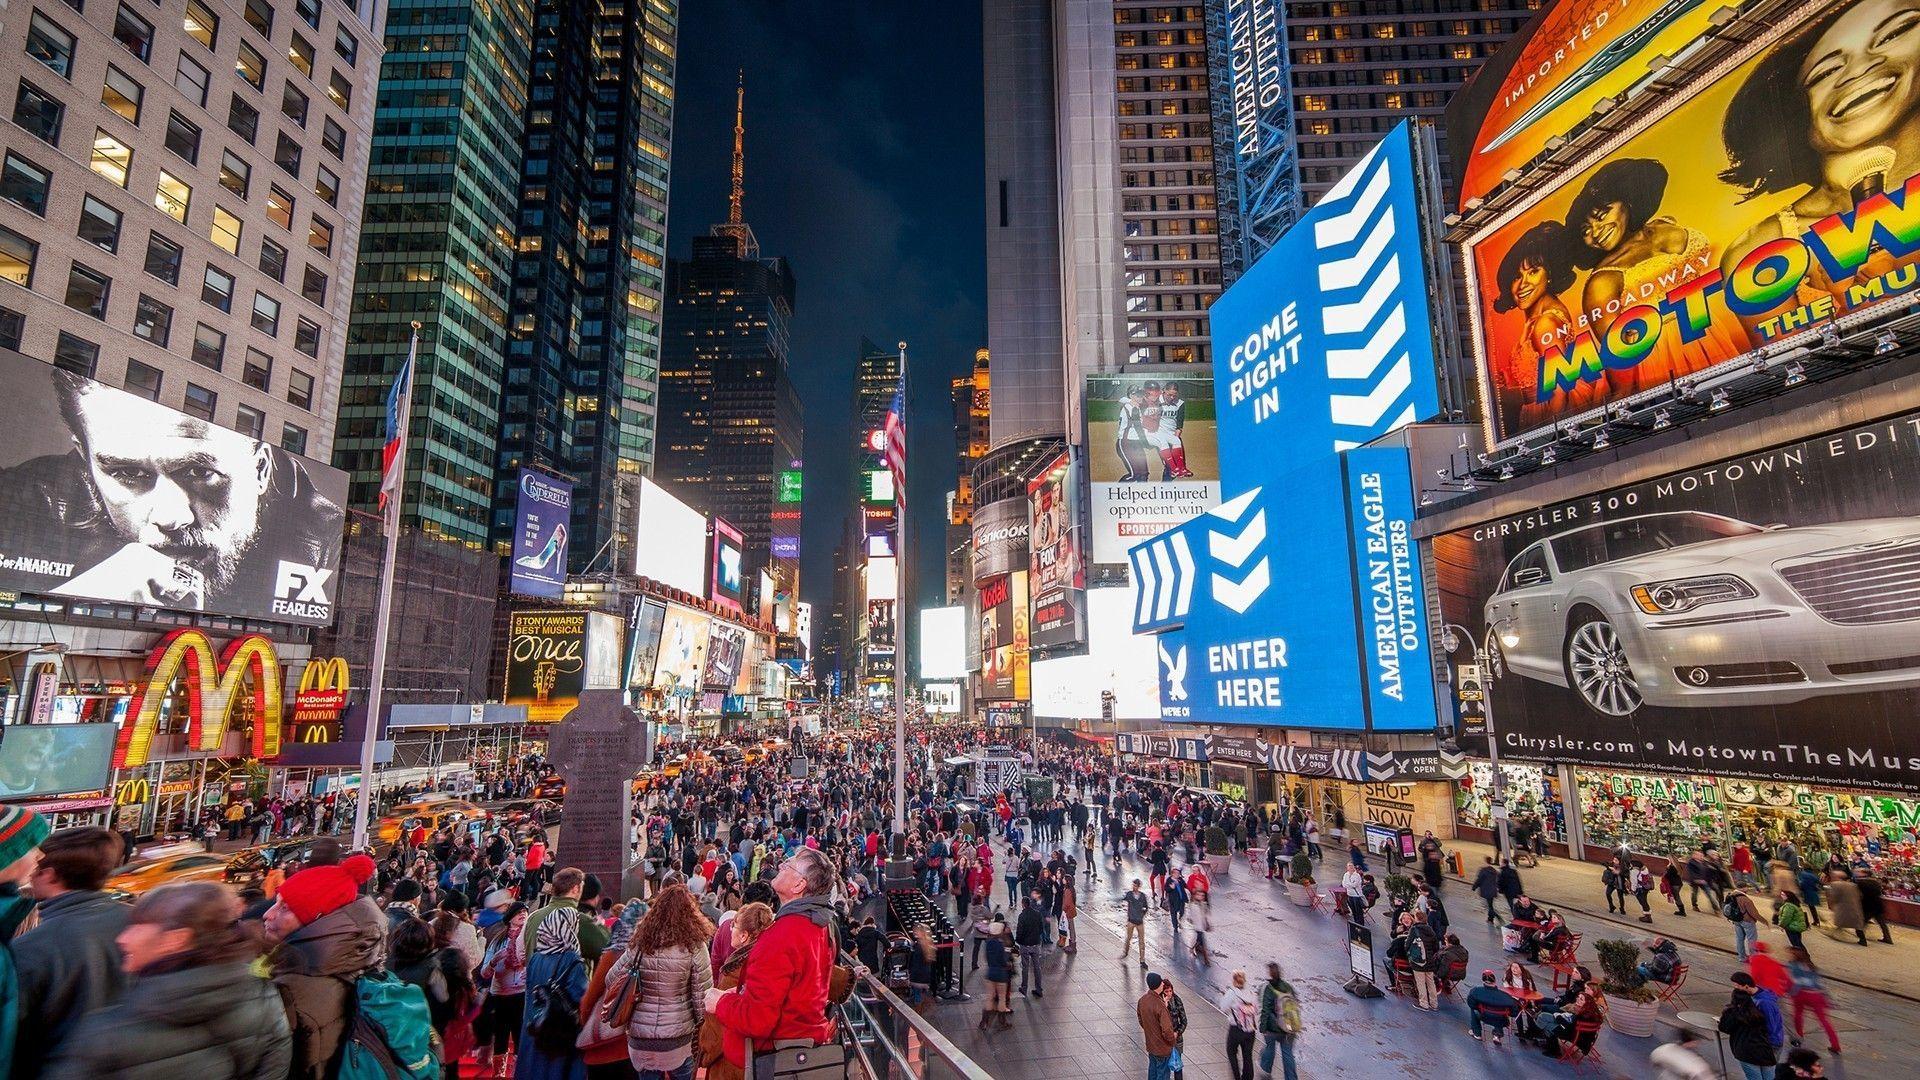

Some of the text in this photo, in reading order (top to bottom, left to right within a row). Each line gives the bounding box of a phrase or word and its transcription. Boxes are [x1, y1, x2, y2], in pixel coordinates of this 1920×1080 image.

[1504, 11, 1609, 108] IMPORTED
[1229, 10, 1259, 155] AMERICAN
[1540, 252, 1714, 346] ON BROADWAY
[1757, 294, 1837, 343] THE
[1230, 300, 1299, 373] COME
[1231, 333, 1302, 407] RIGHT
[1253, 386, 1280, 424] IN
[1107, 480, 1209, 504] Helped injured
[1473, 420, 1920, 543] CHRYSLER 300 MOTOWN EDIT
[1109, 504, 1174, 519] opponent
[14, 556, 76, 578] ANARCHY
[275, 560, 333, 604] FX
[982, 577, 1008, 610] Kodak
[1360, 472, 1404, 702] AMERICAN EAGLE
[1389, 519, 1419, 651] OUTFITTERS
[271, 600, 329, 620] FEARLESS
[516, 616, 584, 626] 8 TONY AWARDS
[515, 626, 584, 635] BEST MUSICAL
[1013, 606, 1028, 666] Kodak
[1208, 637, 1288, 673] ENTER
[297, 695, 343, 704] McDonald's
[1217, 677, 1282, 707] HERE
[1162, 706, 1182, 717] WE'RE
[1217, 746, 1252, 758] ENTER HERE
[1309, 753, 1329, 762] WE'RE
[1309, 760, 1327, 770] OPEN
[1412, 757, 1439, 765] WE'RE
[1505, 732, 1920, 772] Chrysler.com MotownTheMus
[1413, 765, 1436, 774] OPEN
[1657, 764, 1686, 773] Recordings
[1748, 771, 1772, 779] license.
[1772, 773, 1801, 782] Chrysler
[1816, 776, 1851, 785] Imported
[1852, 778, 1872, 787] from
[1872, 780, 1903, 789] Detroit
[1365, 783, 1411, 801] SHOP
[1611, 775, 1920, 828] GRAND SLAM
[1368, 807, 1412, 828] NOW
